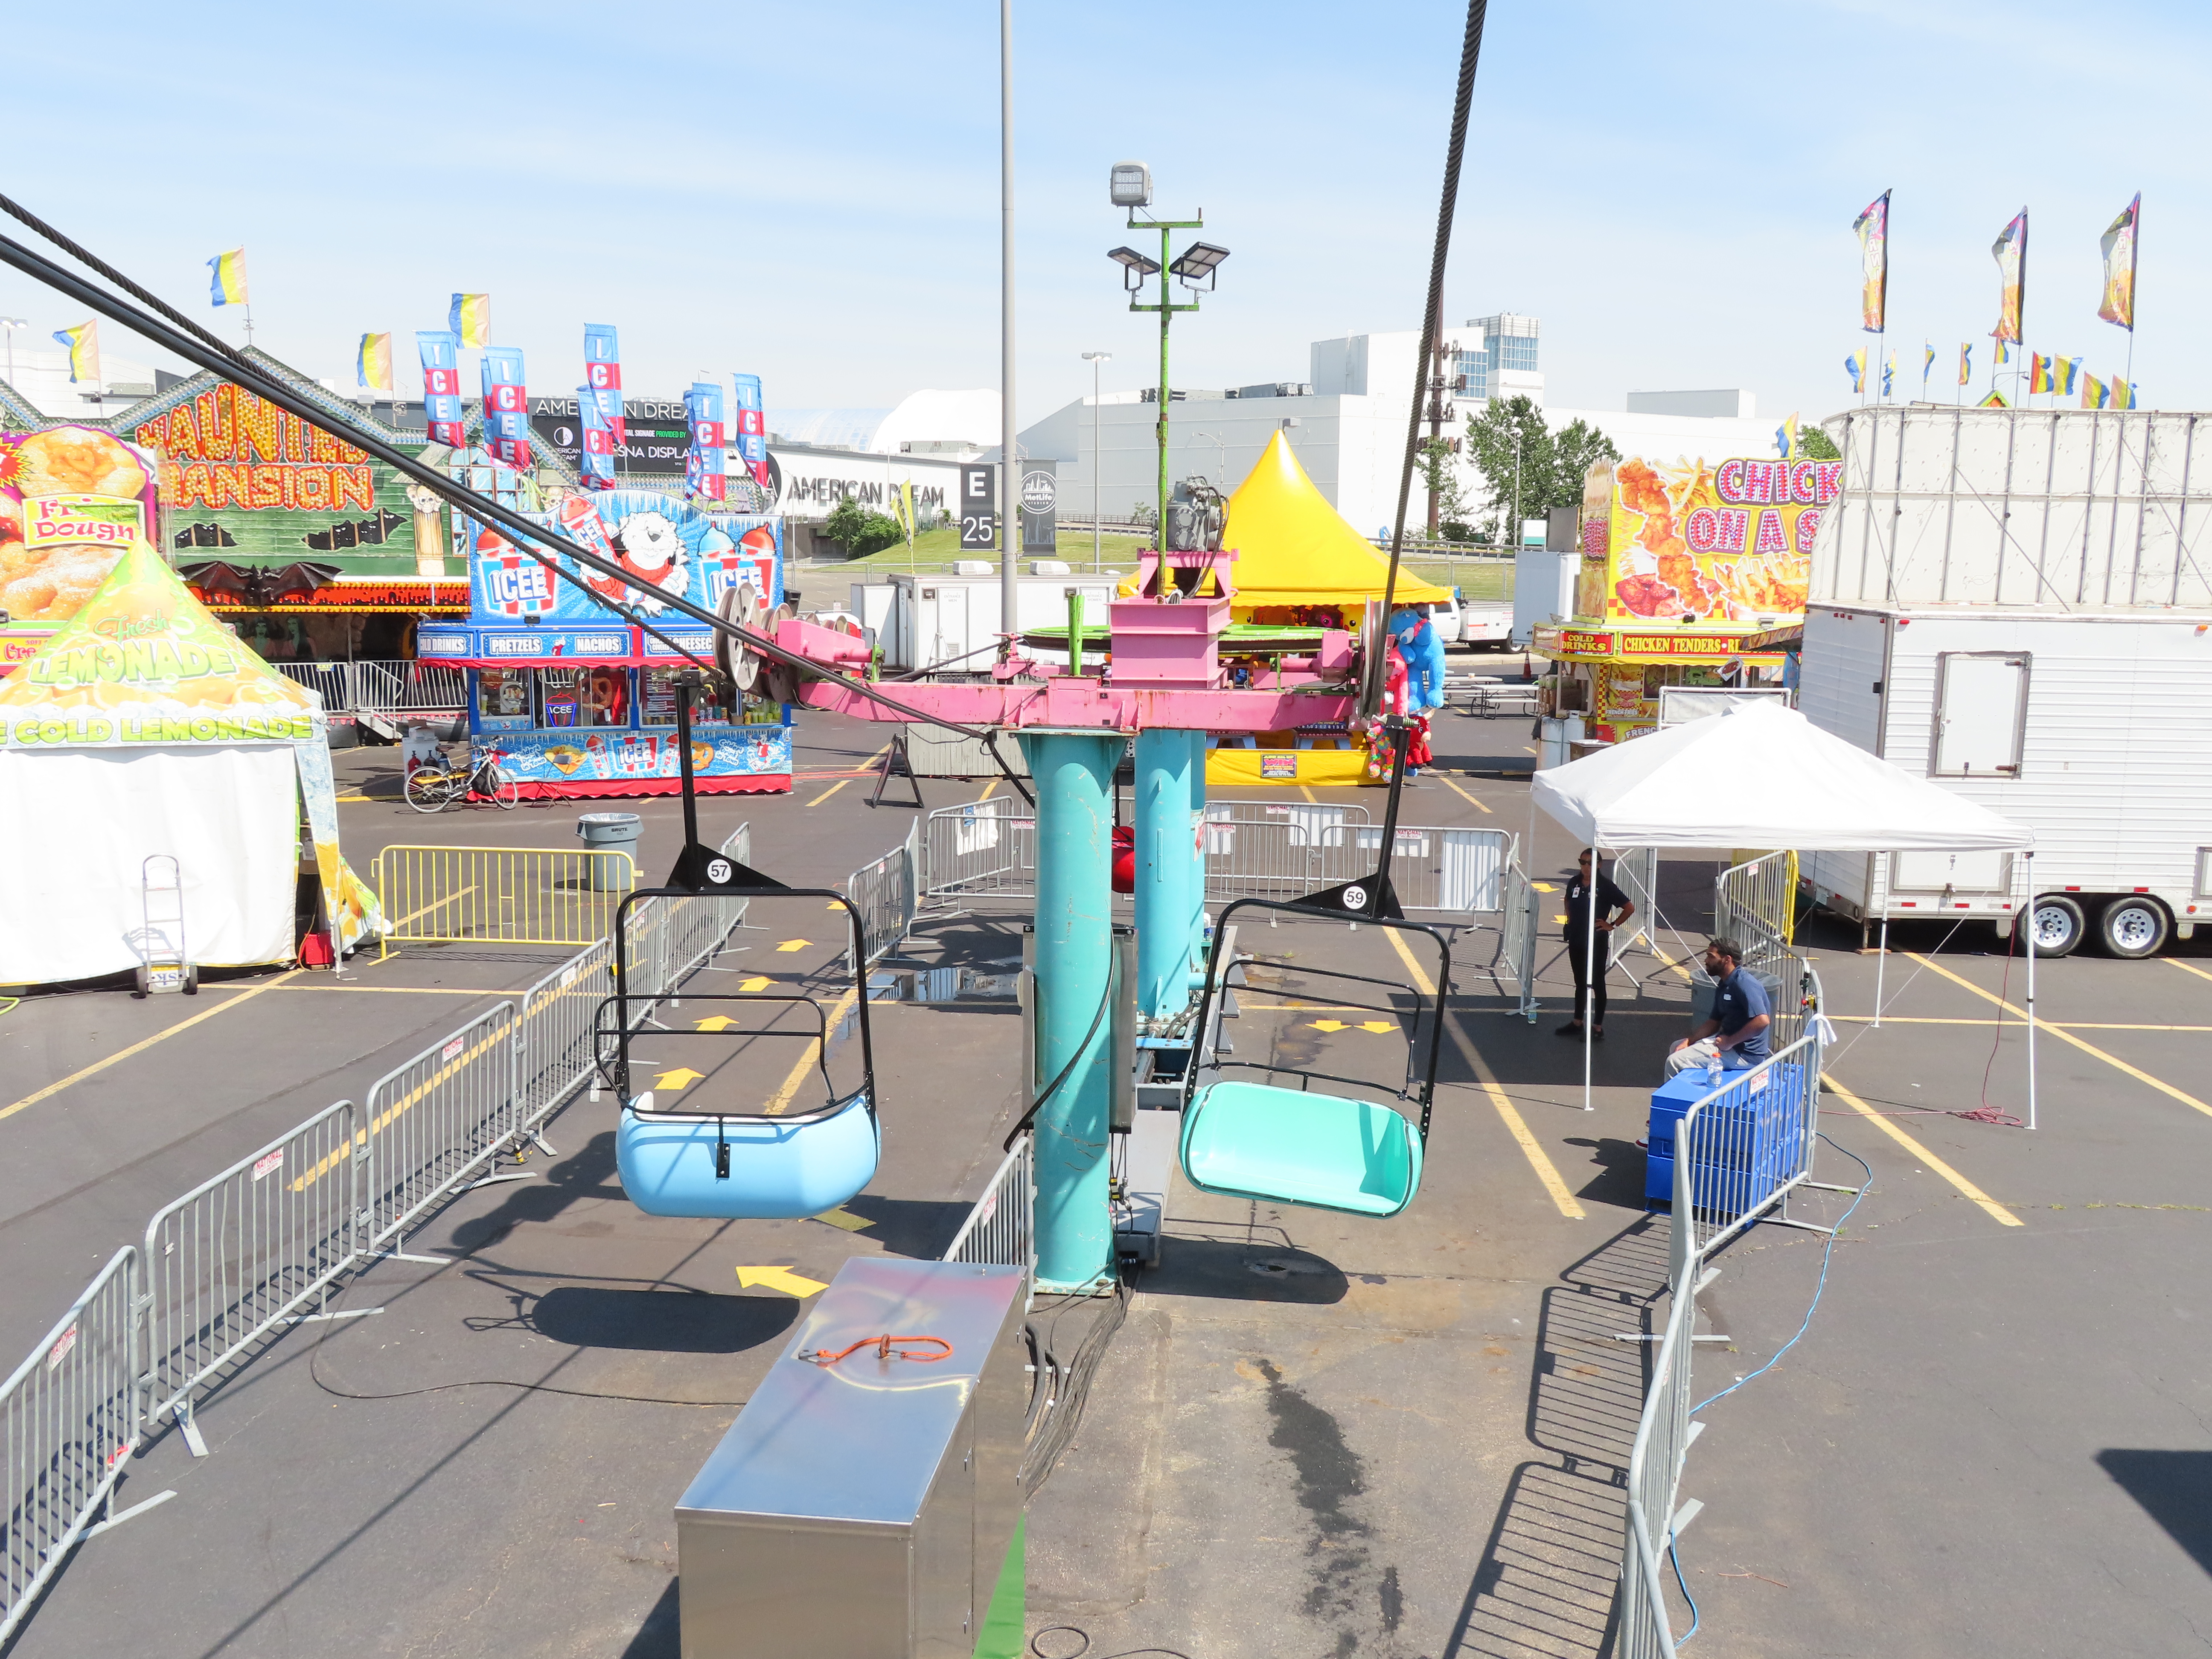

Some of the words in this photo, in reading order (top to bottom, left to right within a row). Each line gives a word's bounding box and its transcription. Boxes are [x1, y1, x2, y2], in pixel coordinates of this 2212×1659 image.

[432, 345, 451, 444] ICEE
[499, 361, 516, 461] ICEE
[617, 446, 645, 458] SNA
[697, 397, 713, 496] ICEE
[788, 476, 882, 504] AMERICAN
[969, 472, 986, 497] E
[34, 521, 134, 541] Dough
[573, 518, 604, 544] ICEE
[963, 516, 992, 542] 25
[1688, 509, 1749, 551] ON
[1756, 509, 1789, 551] A
[490, 566, 548, 603] ICEE
[709, 567, 764, 603] ICEE
[94, 608, 172, 643] Fresh
[432, 637, 465, 652] DRINKS
[492, 638, 541, 653] PRETZELS
[576, 638, 620, 652] NACHOS
[1568, 634, 1595, 643] COLD
[1624, 637, 1671, 652] CHICKEN
[1673, 637, 1721, 653] TENDERS
[1562, 641, 1607, 652] DRINKS
[29, 640, 236, 684] LEMONADE
[549, 705, 573, 714] ICEE
[15, 719, 113, 744] COLD
[121, 715, 313, 742] LEMONADE
[1625, 727, 1656, 739] FRENC
[617, 742, 652, 765] ICEE
[665, 748, 678, 757] ICEE
[719, 740, 743, 752] Coldest
[721, 748, 736, 757] Drink
[530, 758, 545, 766] Town
[591, 748, 606, 761] ICEE
[725, 755, 738, 764] Town
[711, 865, 728, 877] 57
[1346, 891, 1363, 904] 59
[443, 1038, 463, 1053] NATIONAL
[1752, 1070, 1768, 1085] NATIONAL
[256, 1148, 282, 1170] NATIONAL
